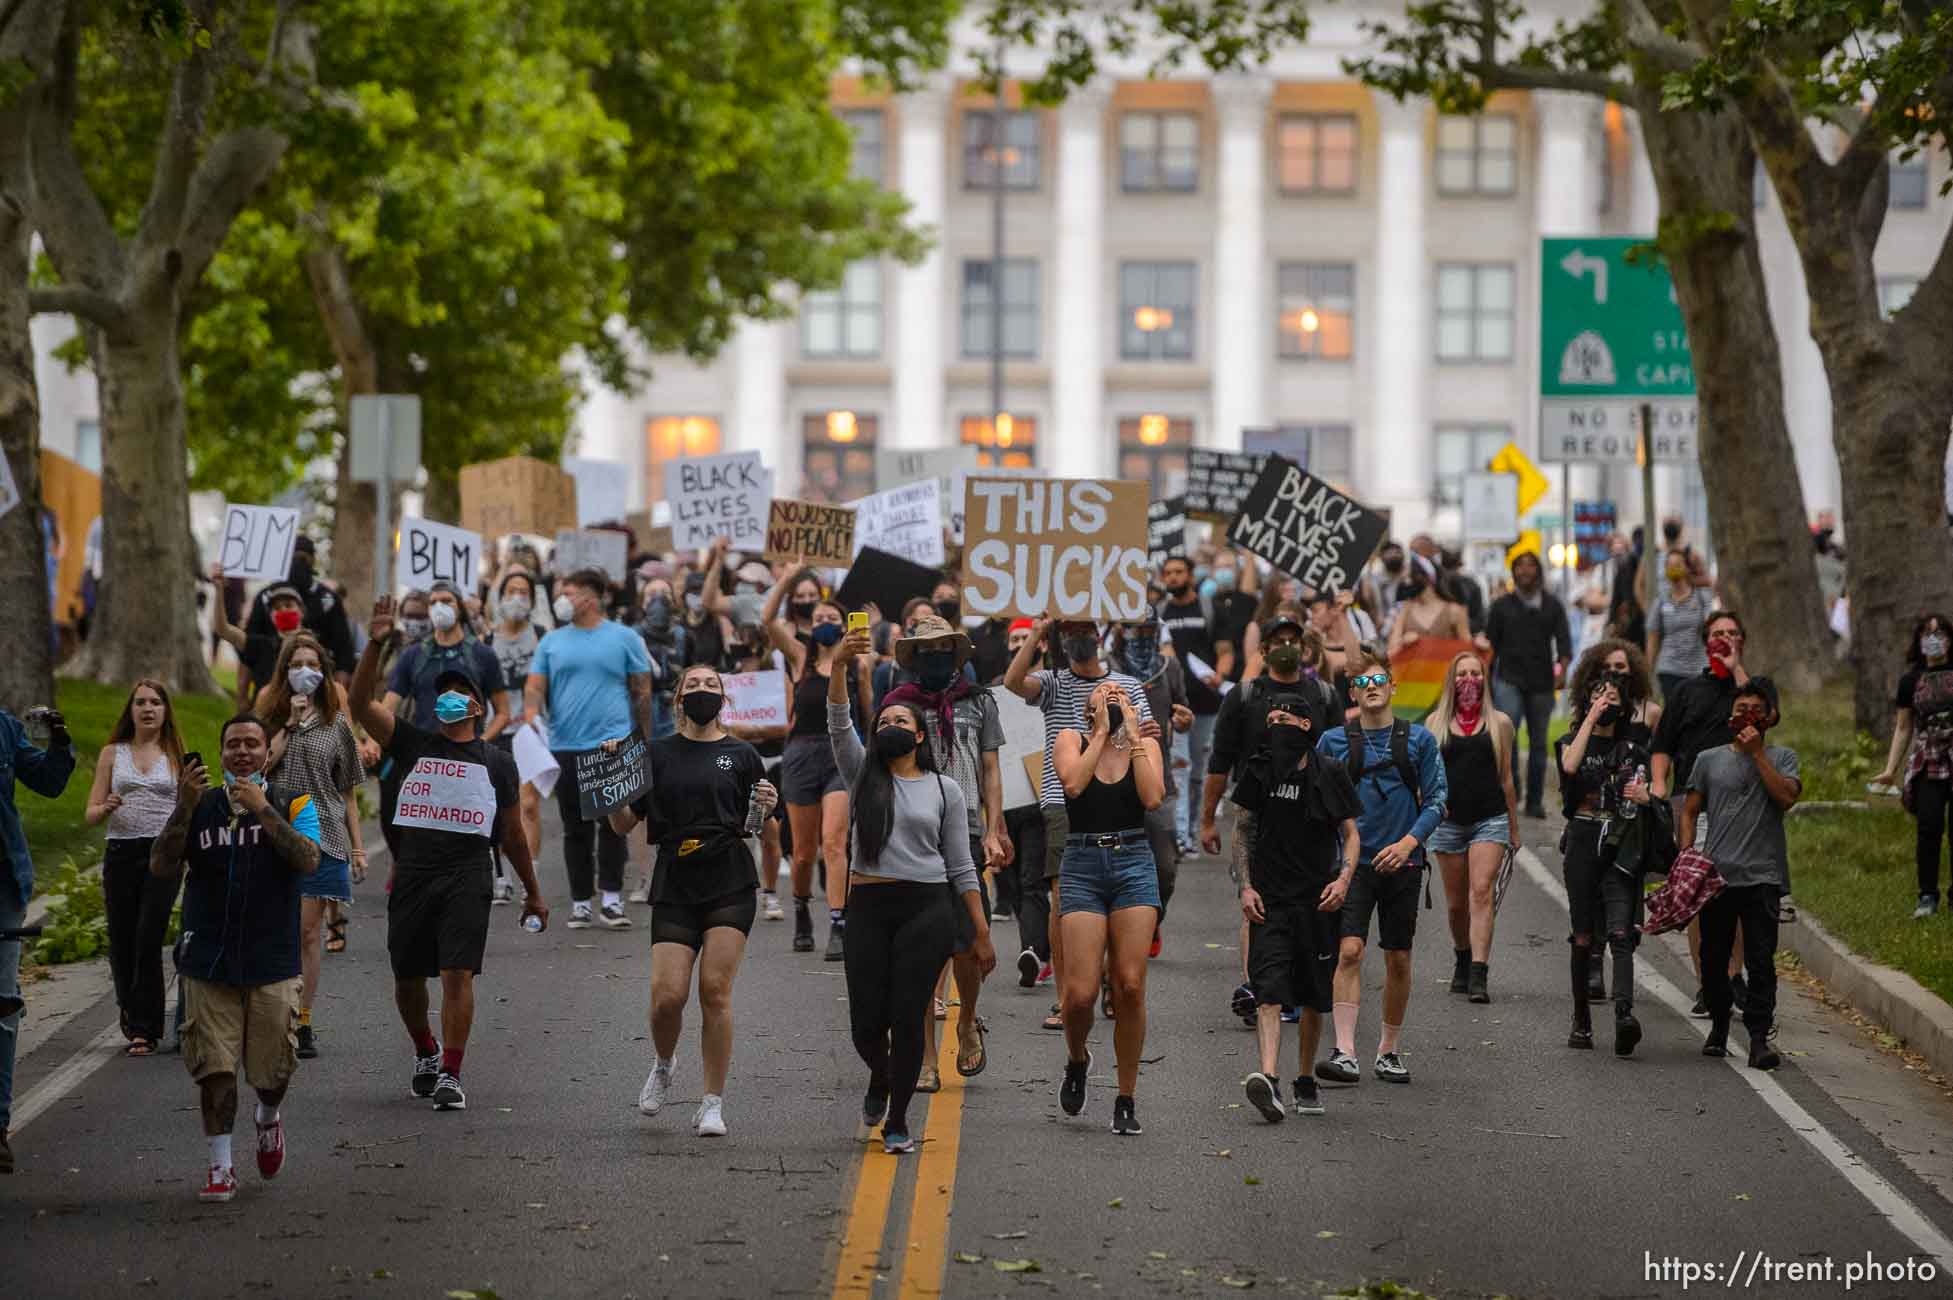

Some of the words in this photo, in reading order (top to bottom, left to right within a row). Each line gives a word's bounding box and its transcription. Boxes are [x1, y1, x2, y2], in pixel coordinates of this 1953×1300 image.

[1569, 408, 1607, 425] NO
[1562, 434, 1689, 456] REQURE
[681, 461, 759, 493] BLACK
[678, 494, 751, 521] LIVES
[770, 501, 799, 523] NO
[973, 481, 1112, 534] THIS
[1277, 465, 1361, 543] BLACK
[222, 508, 296, 577] BLM
[769, 528, 792, 552] NO
[1264, 498, 1345, 565] LIVES
[410, 528, 470, 587] BLM
[1234, 513, 1346, 594] MATTER
[964, 539, 1149, 622] SUCKS
[415, 760, 467, 779] JUSTICE
[402, 782, 432, 796] FOR
[400, 803, 485, 826] BERNARDO
[200, 824, 262, 849] UNIT
